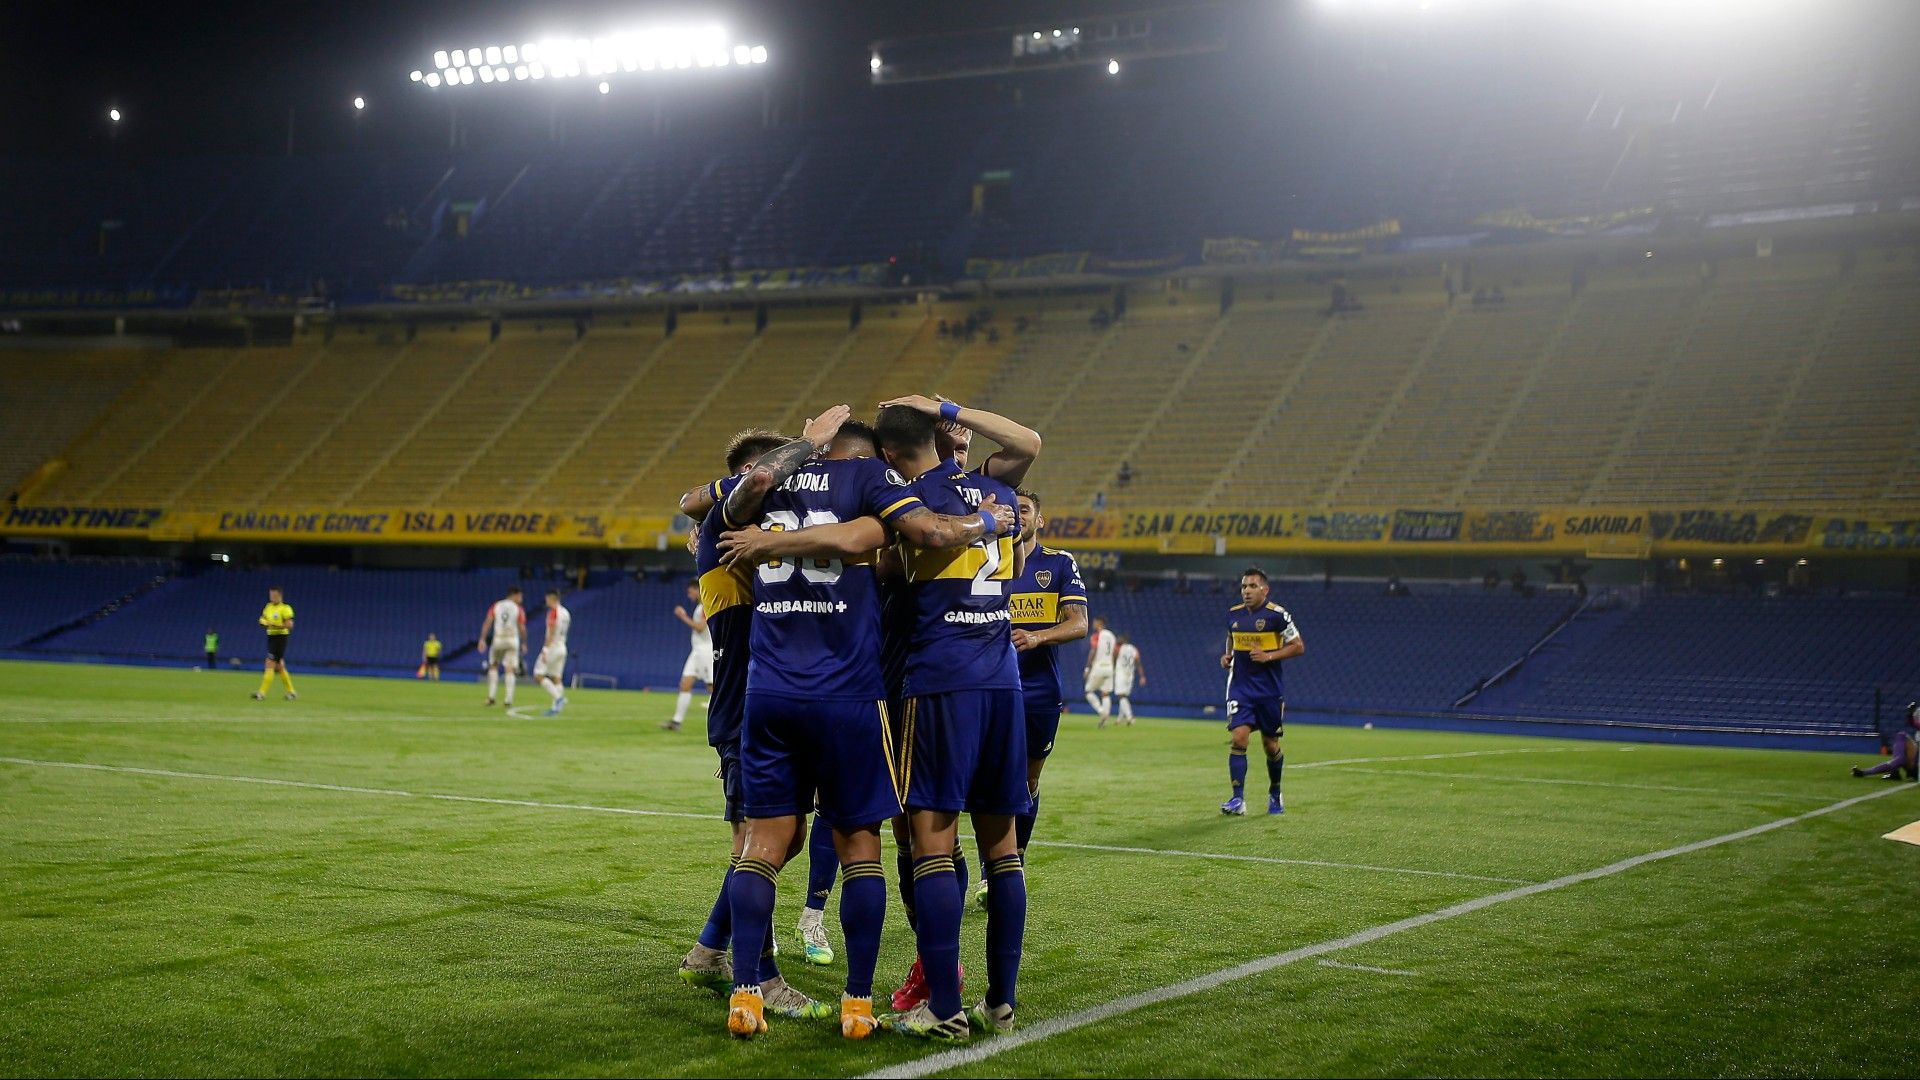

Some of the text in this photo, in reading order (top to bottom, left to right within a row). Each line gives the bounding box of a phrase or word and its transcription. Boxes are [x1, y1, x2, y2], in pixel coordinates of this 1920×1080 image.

[5, 507, 162, 528] MARTINEZ
[220, 511, 390, 534] CAÑADA DE GOMEZ
[401, 511, 455, 532] ISLA
[465, 513, 544, 534] VERDE
[1134, 512, 1175, 536] SAN
[1564, 516, 1643, 535] SAKURA
[971, 535, 1002, 596] 2
[1009, 597, 1044, 610] ATAR
